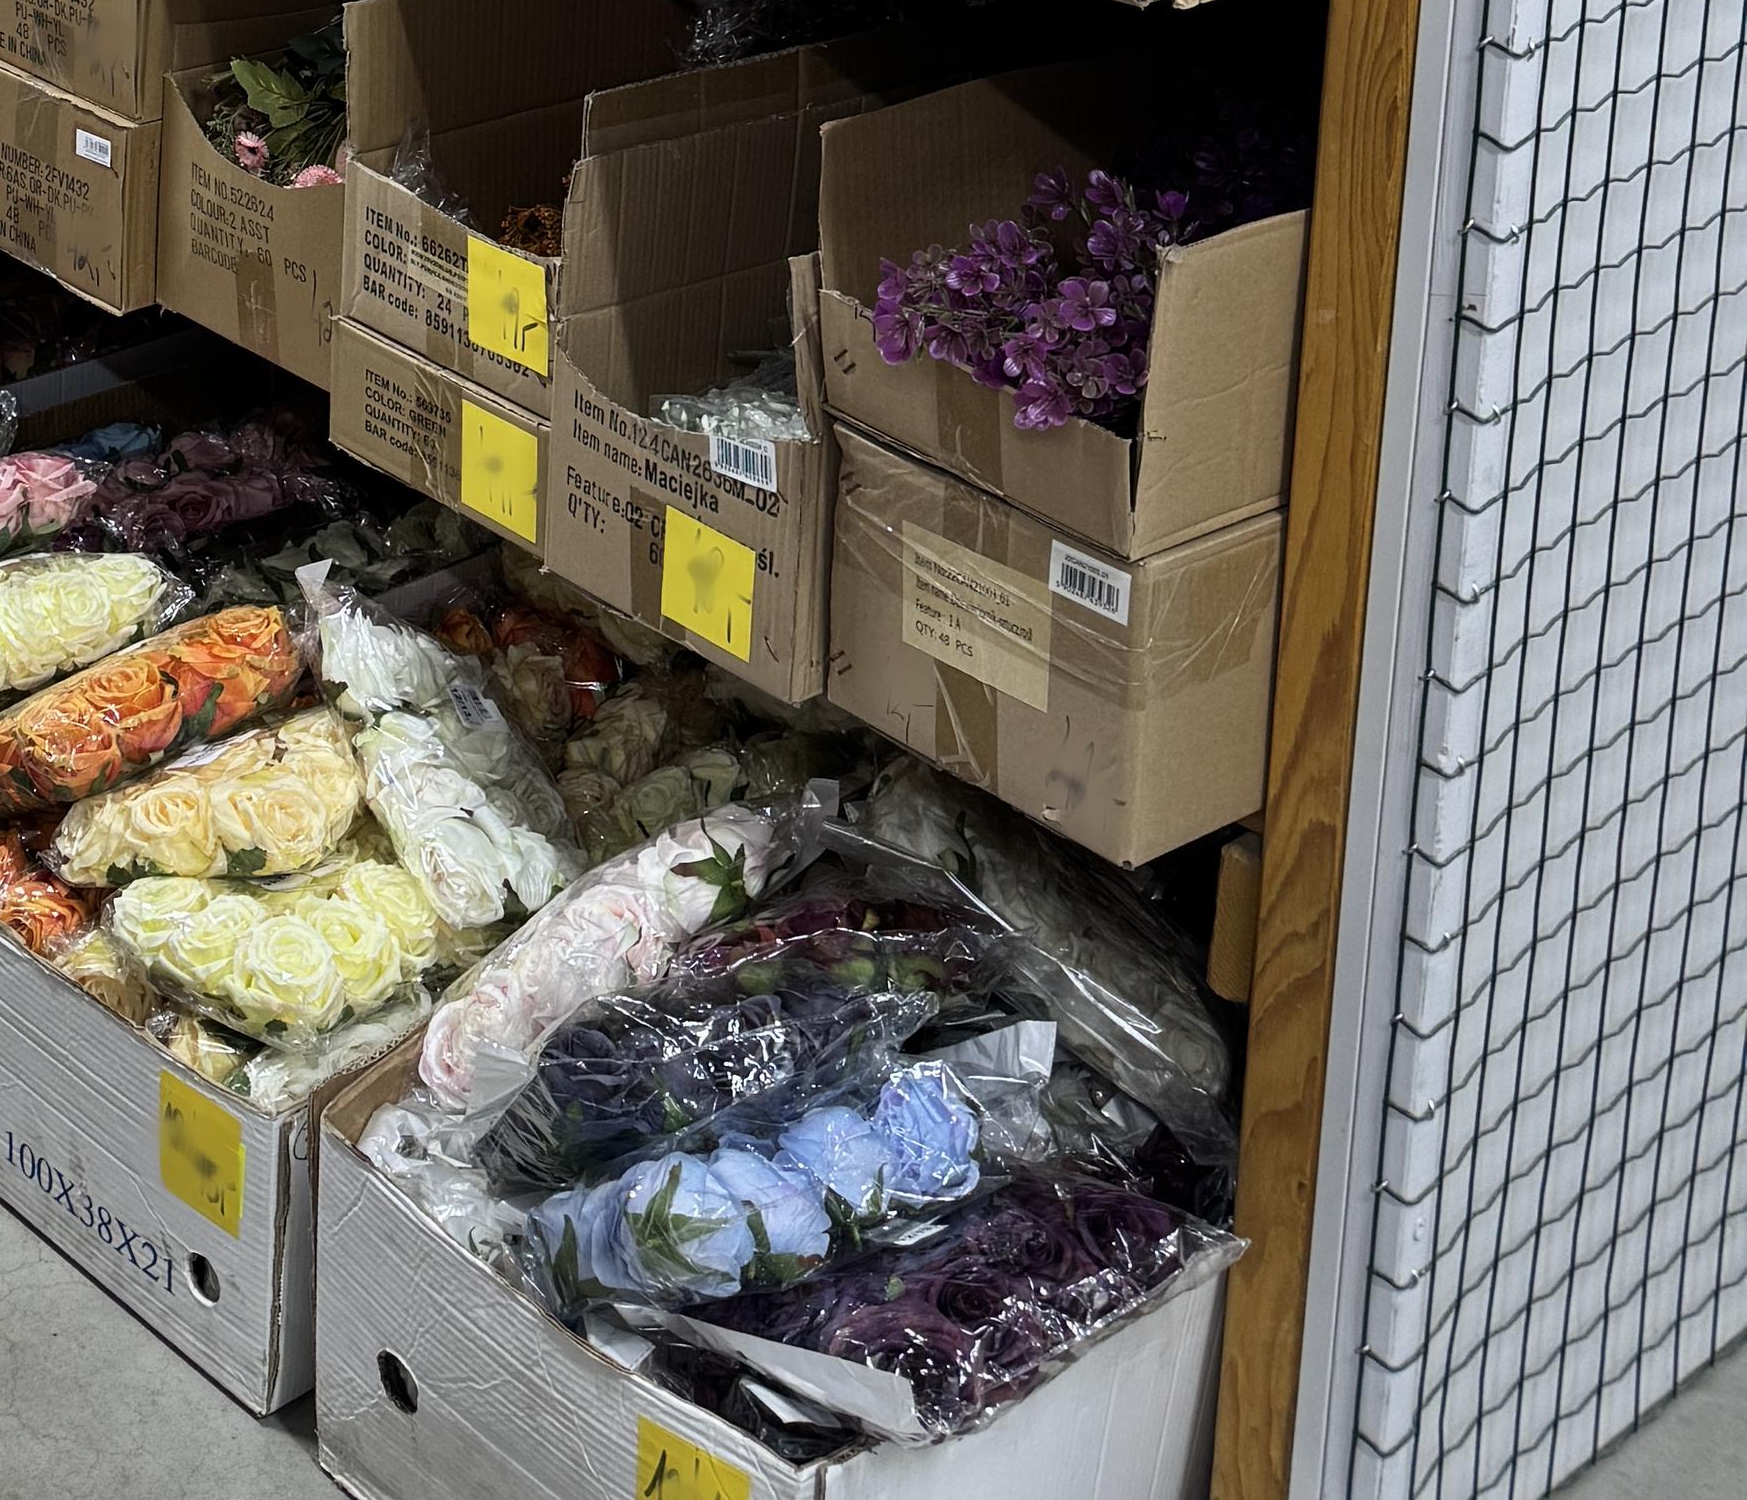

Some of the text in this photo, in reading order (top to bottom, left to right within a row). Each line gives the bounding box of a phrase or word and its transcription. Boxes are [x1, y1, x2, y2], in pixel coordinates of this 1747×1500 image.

[7, 35, 17, 54] IN
[16, 22, 67, 57] 48 PCS
[191, 162, 211, 191] ITEM
[9, 224, 37, 255] CHINA
[240, 216, 270, 245] ASST
[365, 206, 418, 249] ITEM No.:
[364, 229, 408, 264] COLOR:
[257, 246, 307, 284] 60 PCS
[363, 252, 426, 300] QUANTITY:
[437, 294, 452, 316] 24
[363, 274, 385, 301] BAR
[387, 292, 419, 320] code:
[365, 368, 390, 392] ITEM
[392, 382, 413, 404] No.:
[365, 386, 447, 438] COLOR: GREEN
[365, 404, 421, 440] QUANTITY:
[573, 389, 605, 427] Item
[365, 420, 387, 443] BAR
[573, 418, 601, 455] Item
[567, 492, 607, 536] Q'TY:
[955, 640, 974, 658] PCS
[5, 1130, 176, 1297] 100X38X21
